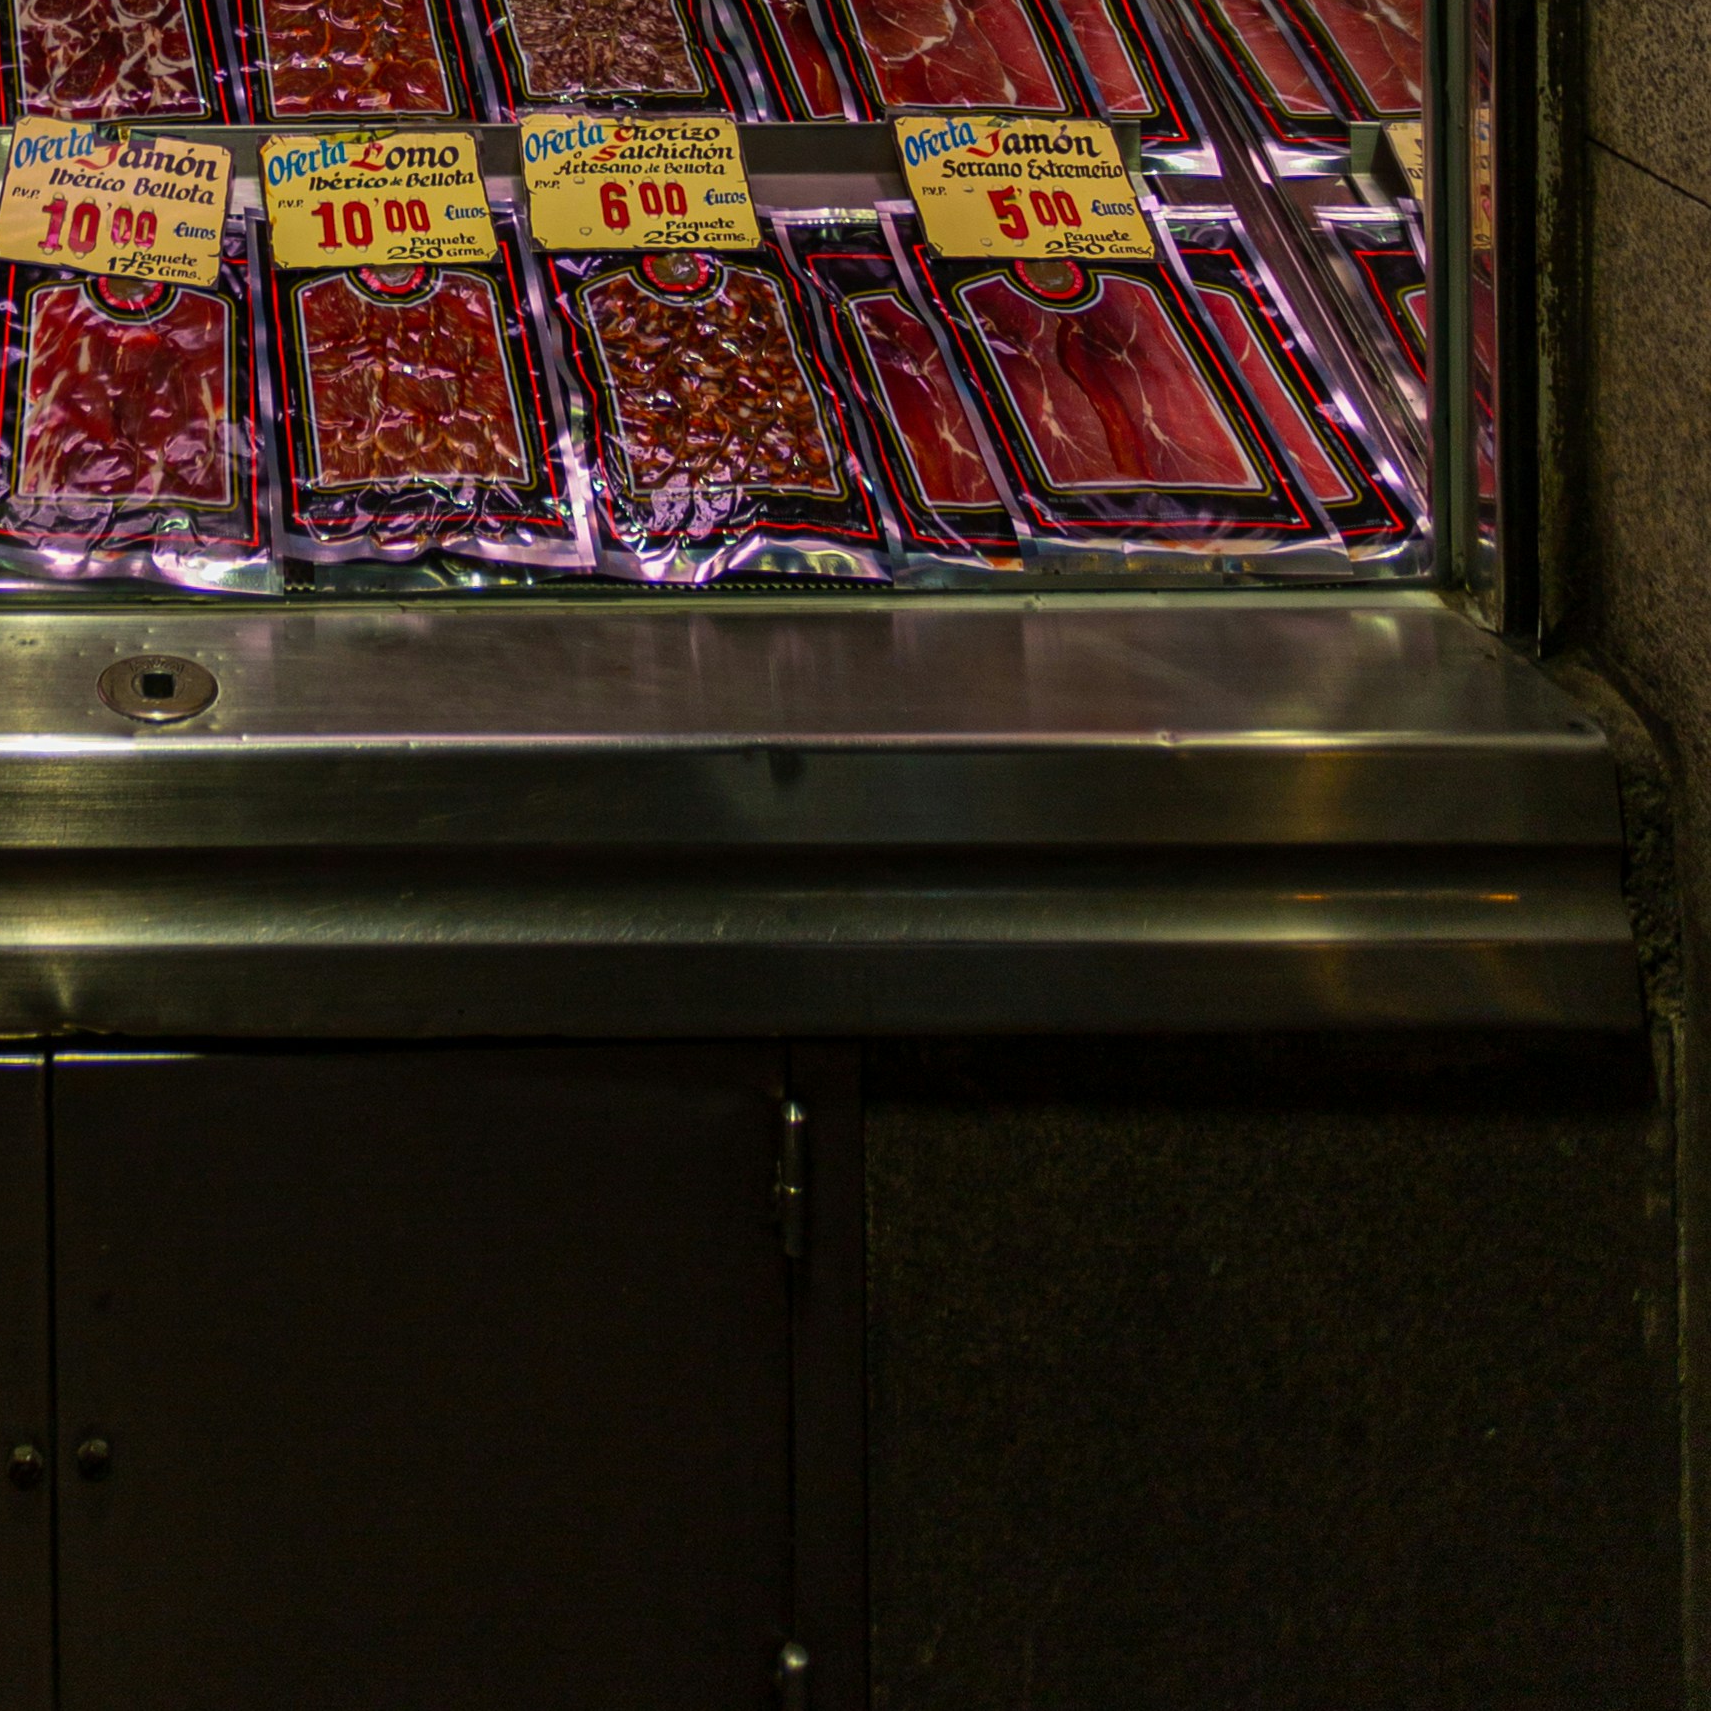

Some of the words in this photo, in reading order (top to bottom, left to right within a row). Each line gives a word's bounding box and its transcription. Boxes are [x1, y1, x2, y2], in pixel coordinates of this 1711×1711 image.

[14, 126, 97, 170] Oferta
[73, 142, 222, 183] Jamón
[524, 119, 610, 164] Oferta
[613, 122, 722, 144] Chorizo
[590, 142, 737, 163] Salchichón
[903, 118, 979, 168] Oferta
[966, 123, 1103, 159] Jamón
[266, 138, 351, 187] Oferta
[348, 141, 461, 173] Lomo
[307, 171, 390, 193] Ibérico
[404, 170, 476, 189] Bellota
[552, 161, 644, 177] Artesano
[663, 161, 727, 176] Bellota
[941, 158, 1023, 179] Serrano
[1027, 158, 1124, 181] Extremeño
[48, 166, 127, 193] Ibérico
[132, 177, 216, 206] Bellota
[599, 178, 689, 230] 6'00
[37, 197, 159, 256] 10'00
[310, 196, 432, 250] 10'00
[986, 184, 1083, 241] 5'00
[385, 245, 444, 261] 250
[643, 230, 701, 245] 250
[1044, 240, 1106, 255] 250
[105, 256, 156, 277] 175
